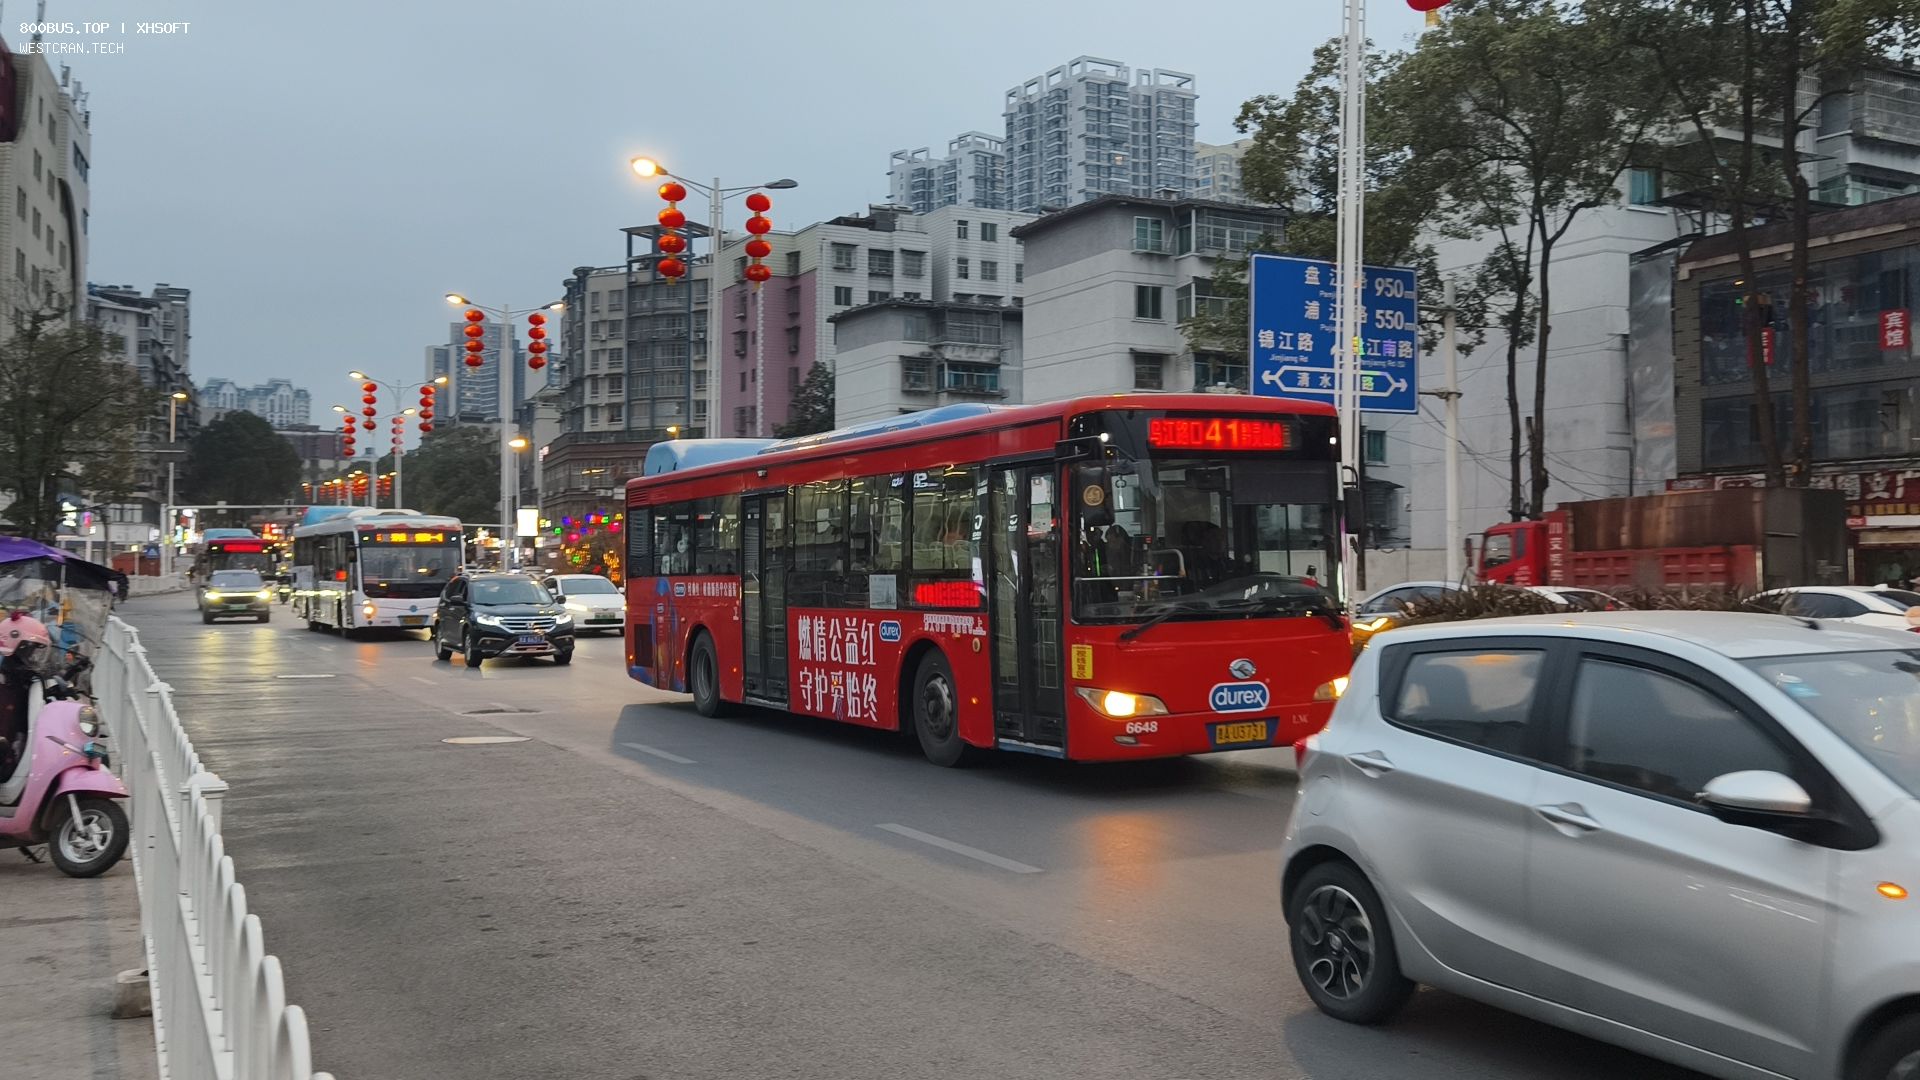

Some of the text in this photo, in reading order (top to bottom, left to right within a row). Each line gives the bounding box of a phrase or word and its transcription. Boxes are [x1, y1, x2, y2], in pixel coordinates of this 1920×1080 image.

[1884, 311, 1905, 347] 宾馆
[1258, 329, 1314, 351] 锦江路
[1297, 372, 1375, 391] 清水路
[1205, 419, 1240, 447] 41
[798, 615, 877, 666] 燃情公益红
[881, 624, 899, 637] durex
[1214, 687, 1265, 708] durex
[1125, 721, 1159, 734] 6648
